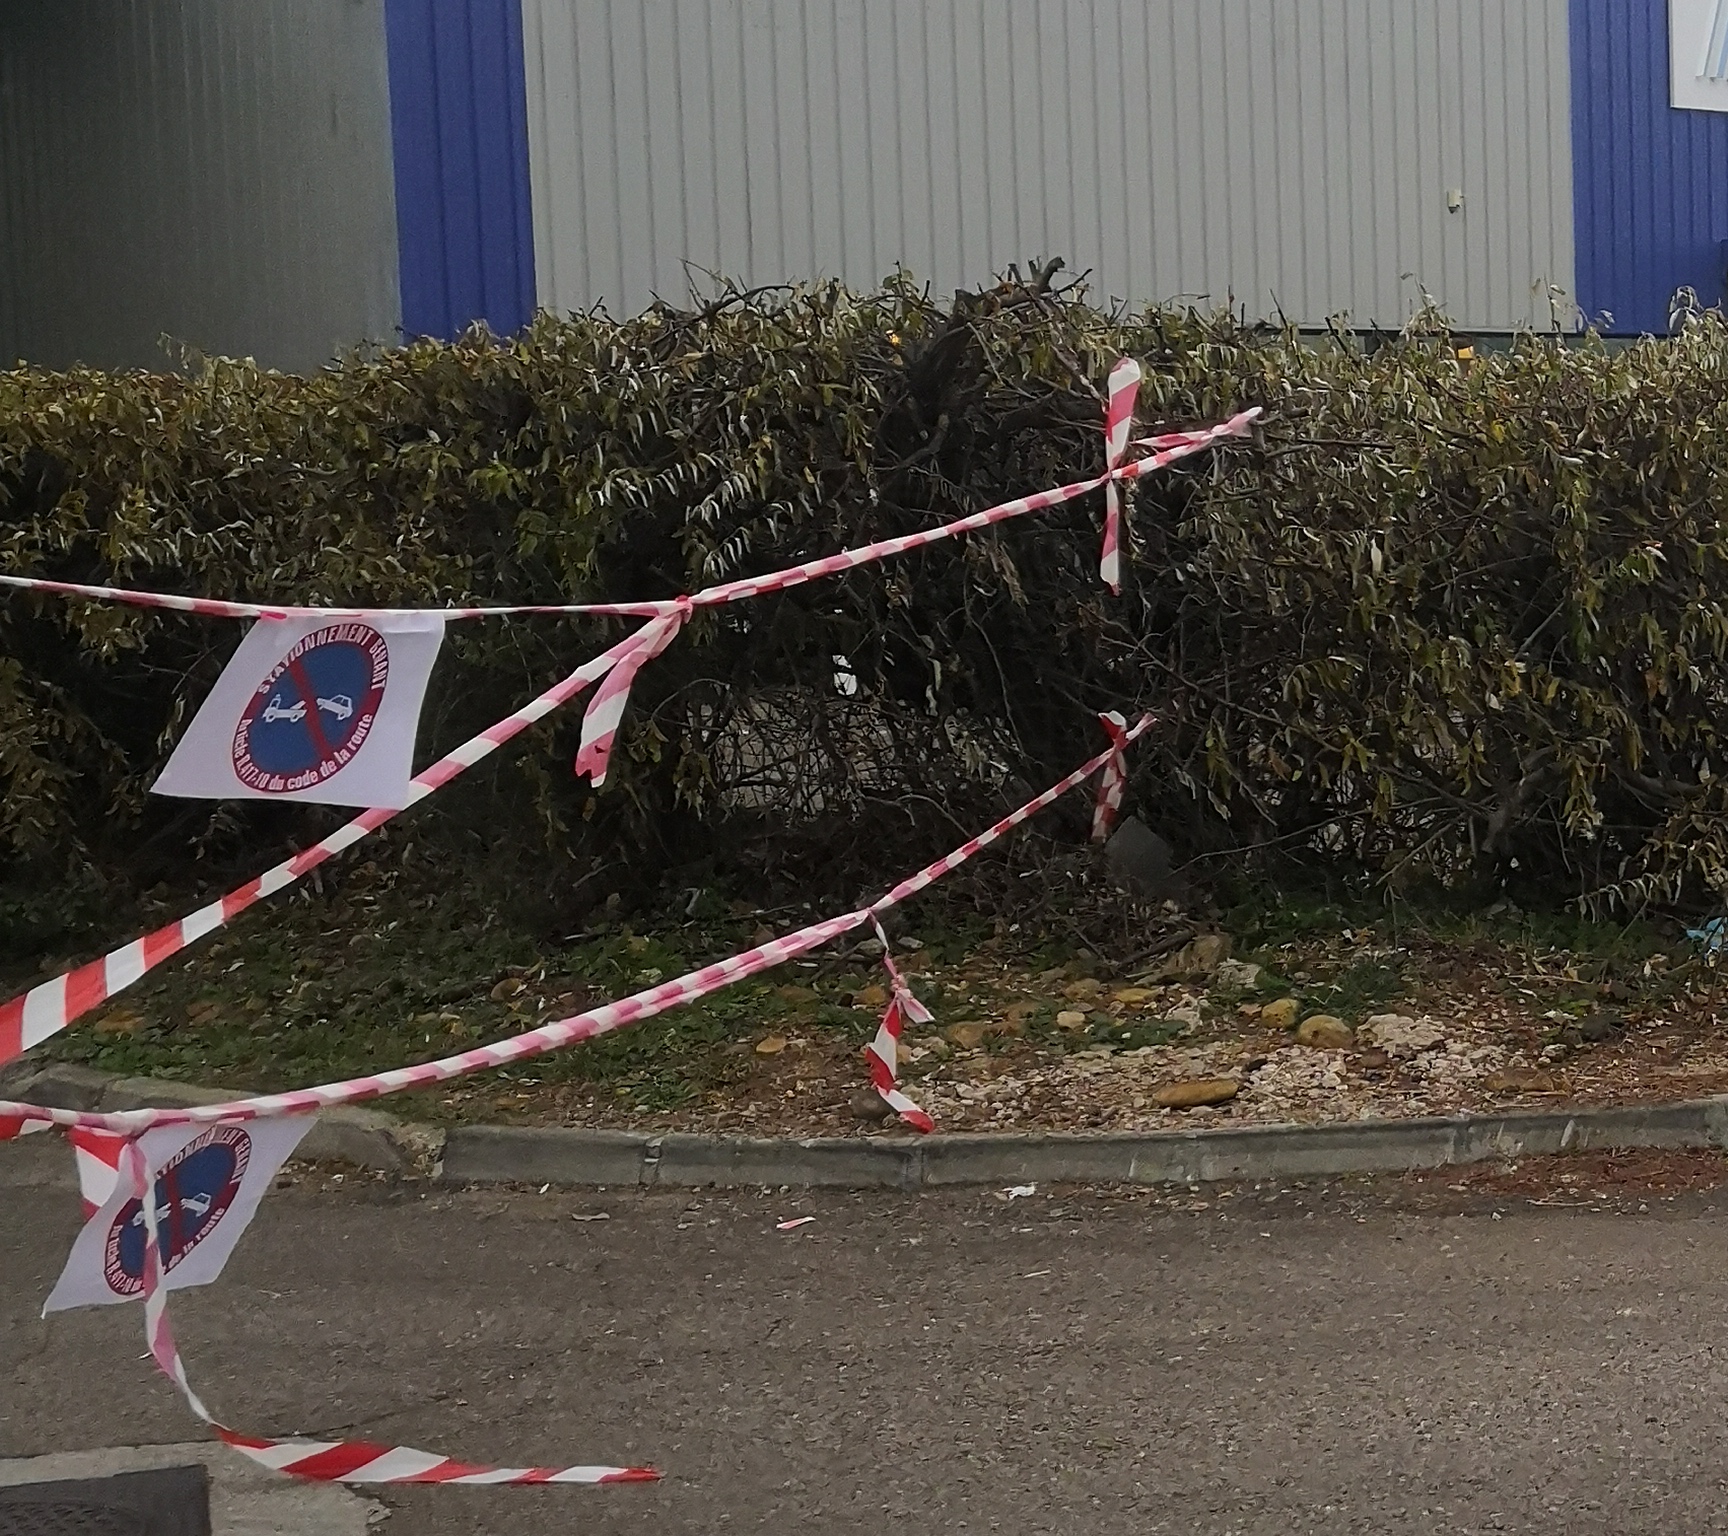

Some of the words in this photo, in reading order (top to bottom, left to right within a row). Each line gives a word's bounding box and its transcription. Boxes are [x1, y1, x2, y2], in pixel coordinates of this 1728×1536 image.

[258, 624, 373, 695] STATIONNEMENT
[234, 719, 253, 758] Article
[268, 775, 285, 791] du
[287, 770, 319, 790] code
[320, 760, 337, 777] de
[333, 748, 351, 764] la
[346, 713, 373, 752] route
